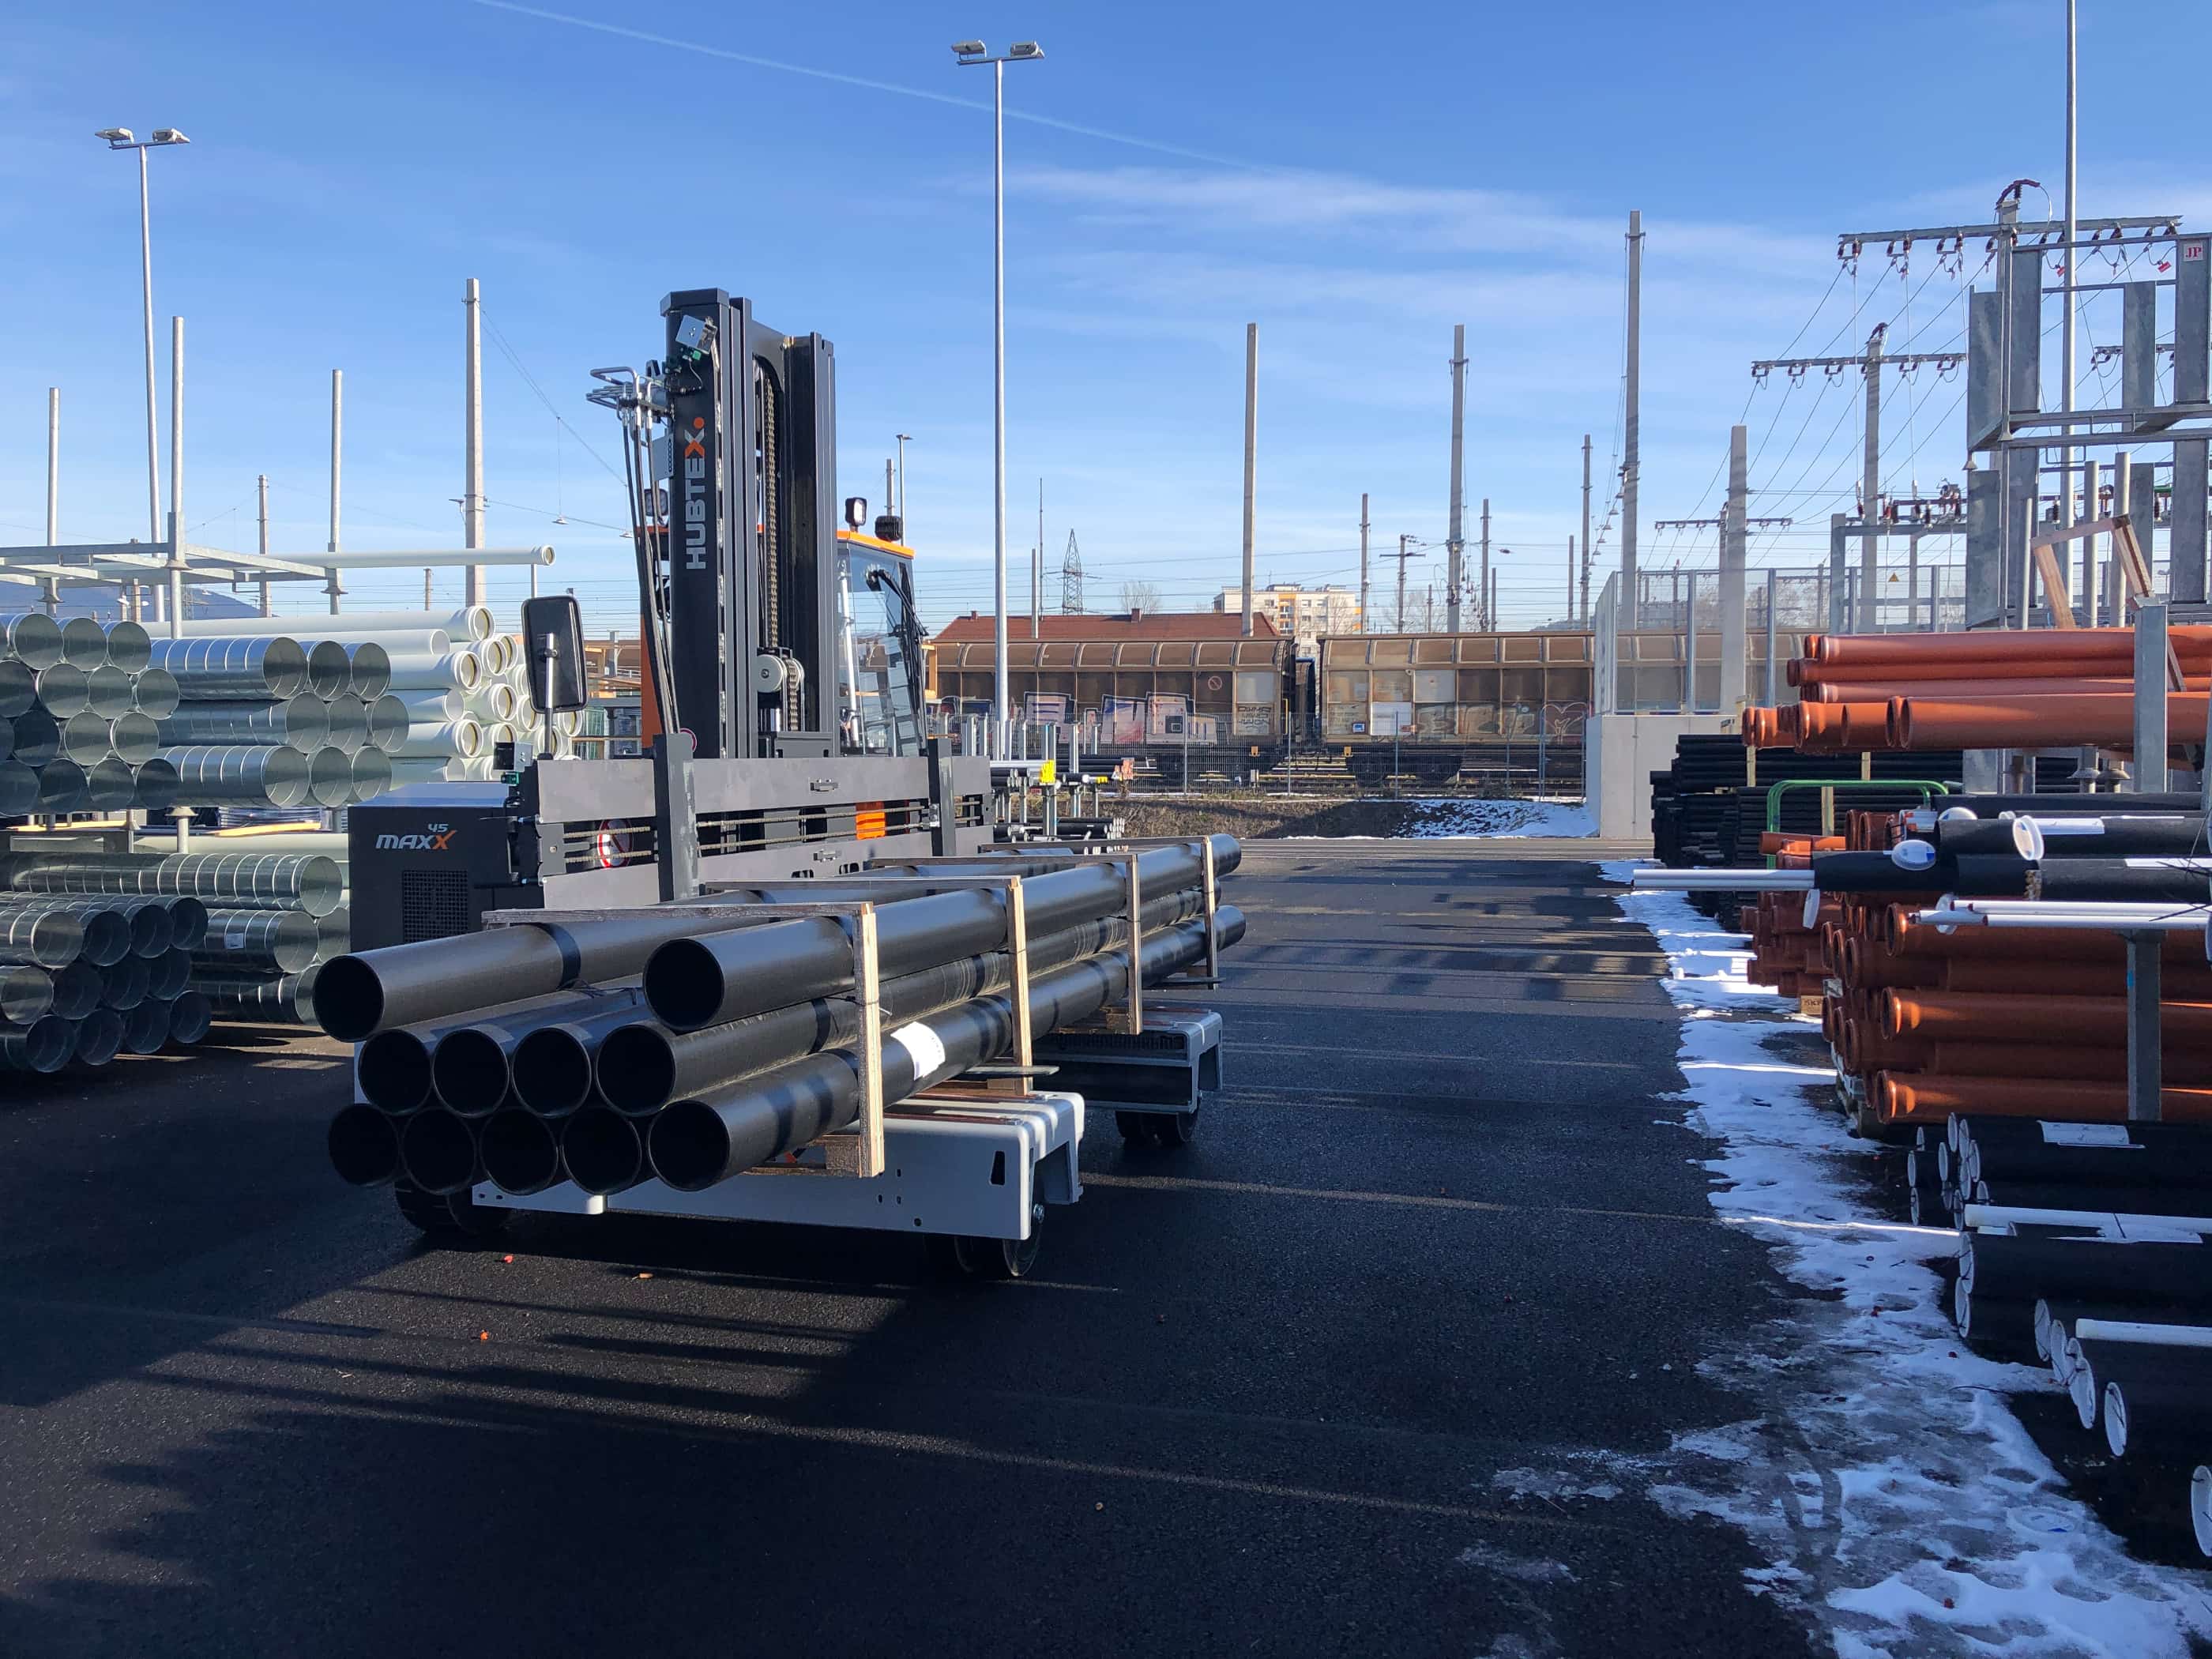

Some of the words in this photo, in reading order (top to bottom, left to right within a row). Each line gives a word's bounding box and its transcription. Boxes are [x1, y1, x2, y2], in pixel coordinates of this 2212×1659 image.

[2185, 246, 2202, 258] JP
[684, 428, 706, 570] HUBTEX
[427, 823, 450, 833] 45
